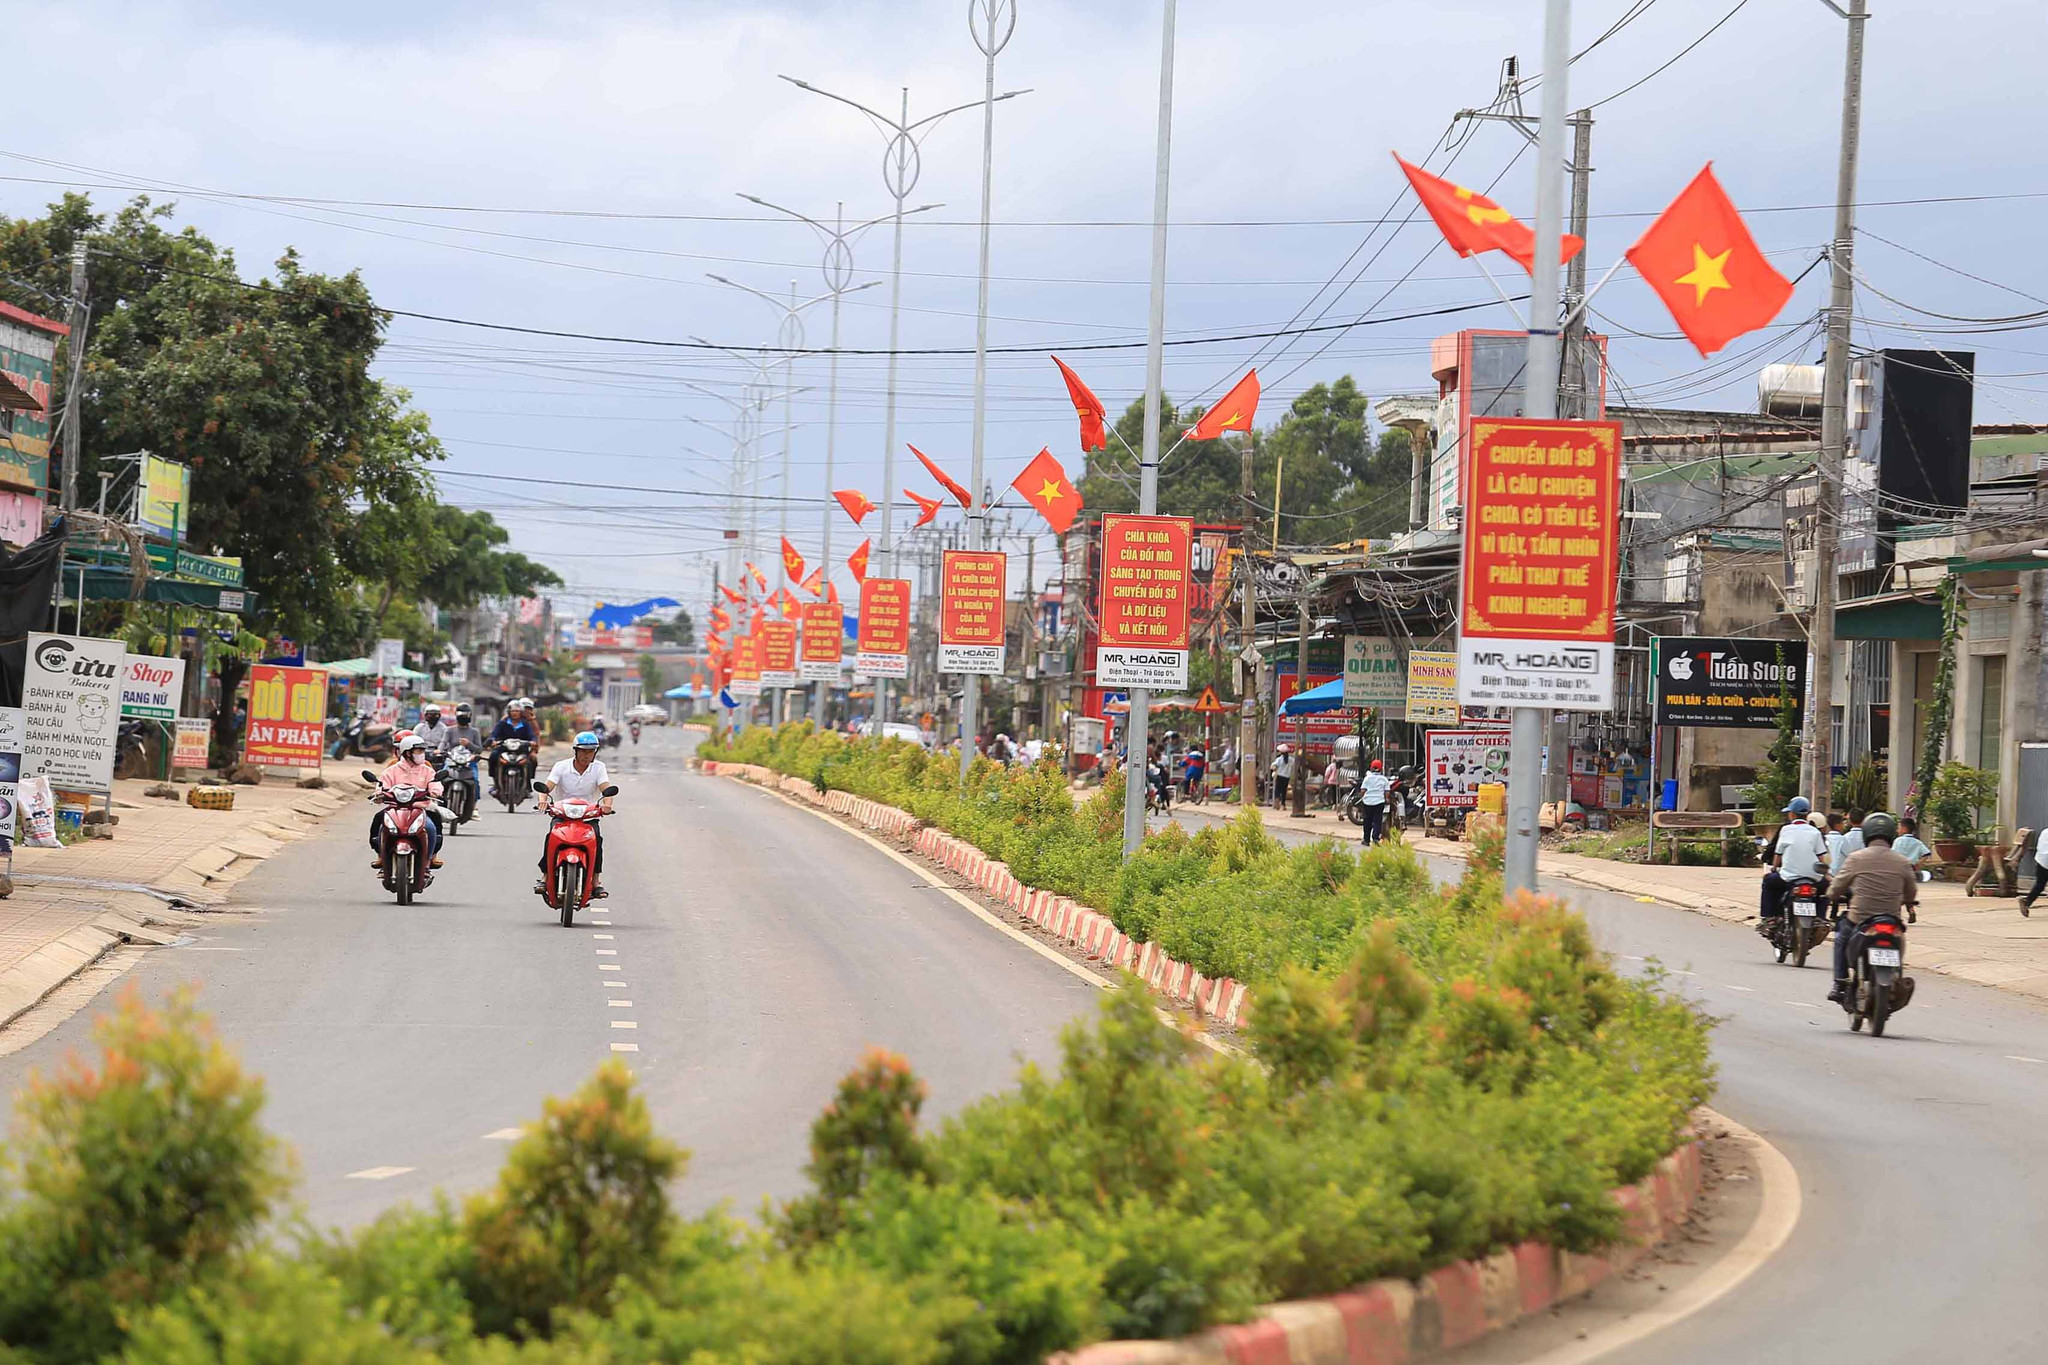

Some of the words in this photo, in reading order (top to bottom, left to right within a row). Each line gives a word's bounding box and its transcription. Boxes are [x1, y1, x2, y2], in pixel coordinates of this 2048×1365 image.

[1490, 440, 1546, 465] CHUYỂN
[1548, 441, 1573, 466] ĐỔI
[1575, 443, 1597, 467] SỐ
[1487, 472, 1506, 493] LÀ
[1508, 473, 1538, 494] CÂU
[1540, 475, 1597, 500] CHUYỆN
[1481, 505, 1520, 524] CHƯA
[1523, 504, 1543, 525] CÓ
[1579, 506, 1601, 531] LỆ
[1125, 529, 1145, 542] CHÌA
[1147, 530, 1170, 543] KHÓA
[1481, 532, 1496, 553] VÌ
[1563, 535, 1600, 557] NHÌN
[1120, 546, 1138, 560] CỦA
[1139, 546, 1154, 561] ĐỔI
[1156, 549, 1173, 562] MỚI
[977, 561, 994, 571] CHÁY
[1110, 565, 1134, 579] SÁNG
[1135, 568, 1151, 582] TẠO
[1154, 569, 1182, 581] TRONG
[1489, 558, 1523, 584] PHẢI
[1525, 566, 1560, 585] THAY
[1563, 563, 1591, 587] THẾ
[952, 573, 960, 583] VÀ
[980, 574, 996, 584] CHÁY
[948, 586, 956, 596] LÀ
[958, 587, 978, 596] TRÁCH
[1113, 582, 1147, 598] CHUYỂN
[1148, 583, 1163, 599] ĐỔI
[1165, 584, 1178, 599] SỐ
[1122, 602, 1132, 616] LÀ
[1134, 603, 1147, 617] DỮ
[1148, 604, 1167, 620] LIỆU
[1488, 595, 1523, 614] KINH
[1119, 621, 1130, 634] VÀ
[1132, 620, 1148, 635] KẾT
[1150, 620, 1168, 636] NỐI!
[1104, 654, 1126, 665] MR.
[1130, 654, 1176, 665] HOÀNG
[1474, 652, 1509, 669] MR.
[1516, 651, 1592, 669] HOÀNG
[1696, 652, 1748, 681] Tuấn
[131, 662, 173, 687] Shop
[1412, 665, 1433, 677] MINH
[69, 677, 111, 691] Bakery
[30, 686, 54, 698] BÁNH
[56, 690, 73, 700] KEM
[152, 691, 169, 705] NỮ
[1666, 694, 1683, 705] MUA
[1685, 692, 1701, 706] BÁN
[1707, 693, 1722, 706] SỬA
[1723, 694, 1744, 707] CHỮA
[29, 702, 52, 712] BÁNH
[28, 717, 44, 726] RAU
[46, 717, 63, 728] CÂU
[26, 730, 49, 741] BÁNH
[52, 733, 61, 742] MÌ
[249, 722, 274, 742] ÂN
[277, 726, 321, 746] PHÁT
[24, 745, 43, 755] ĐÀO
[44, 747, 61, 758] TẠO
[63, 749, 80, 760] HỌC
[82, 749, 102, 761] VIÊN
[1449, 797, 1473, 805] 0356
